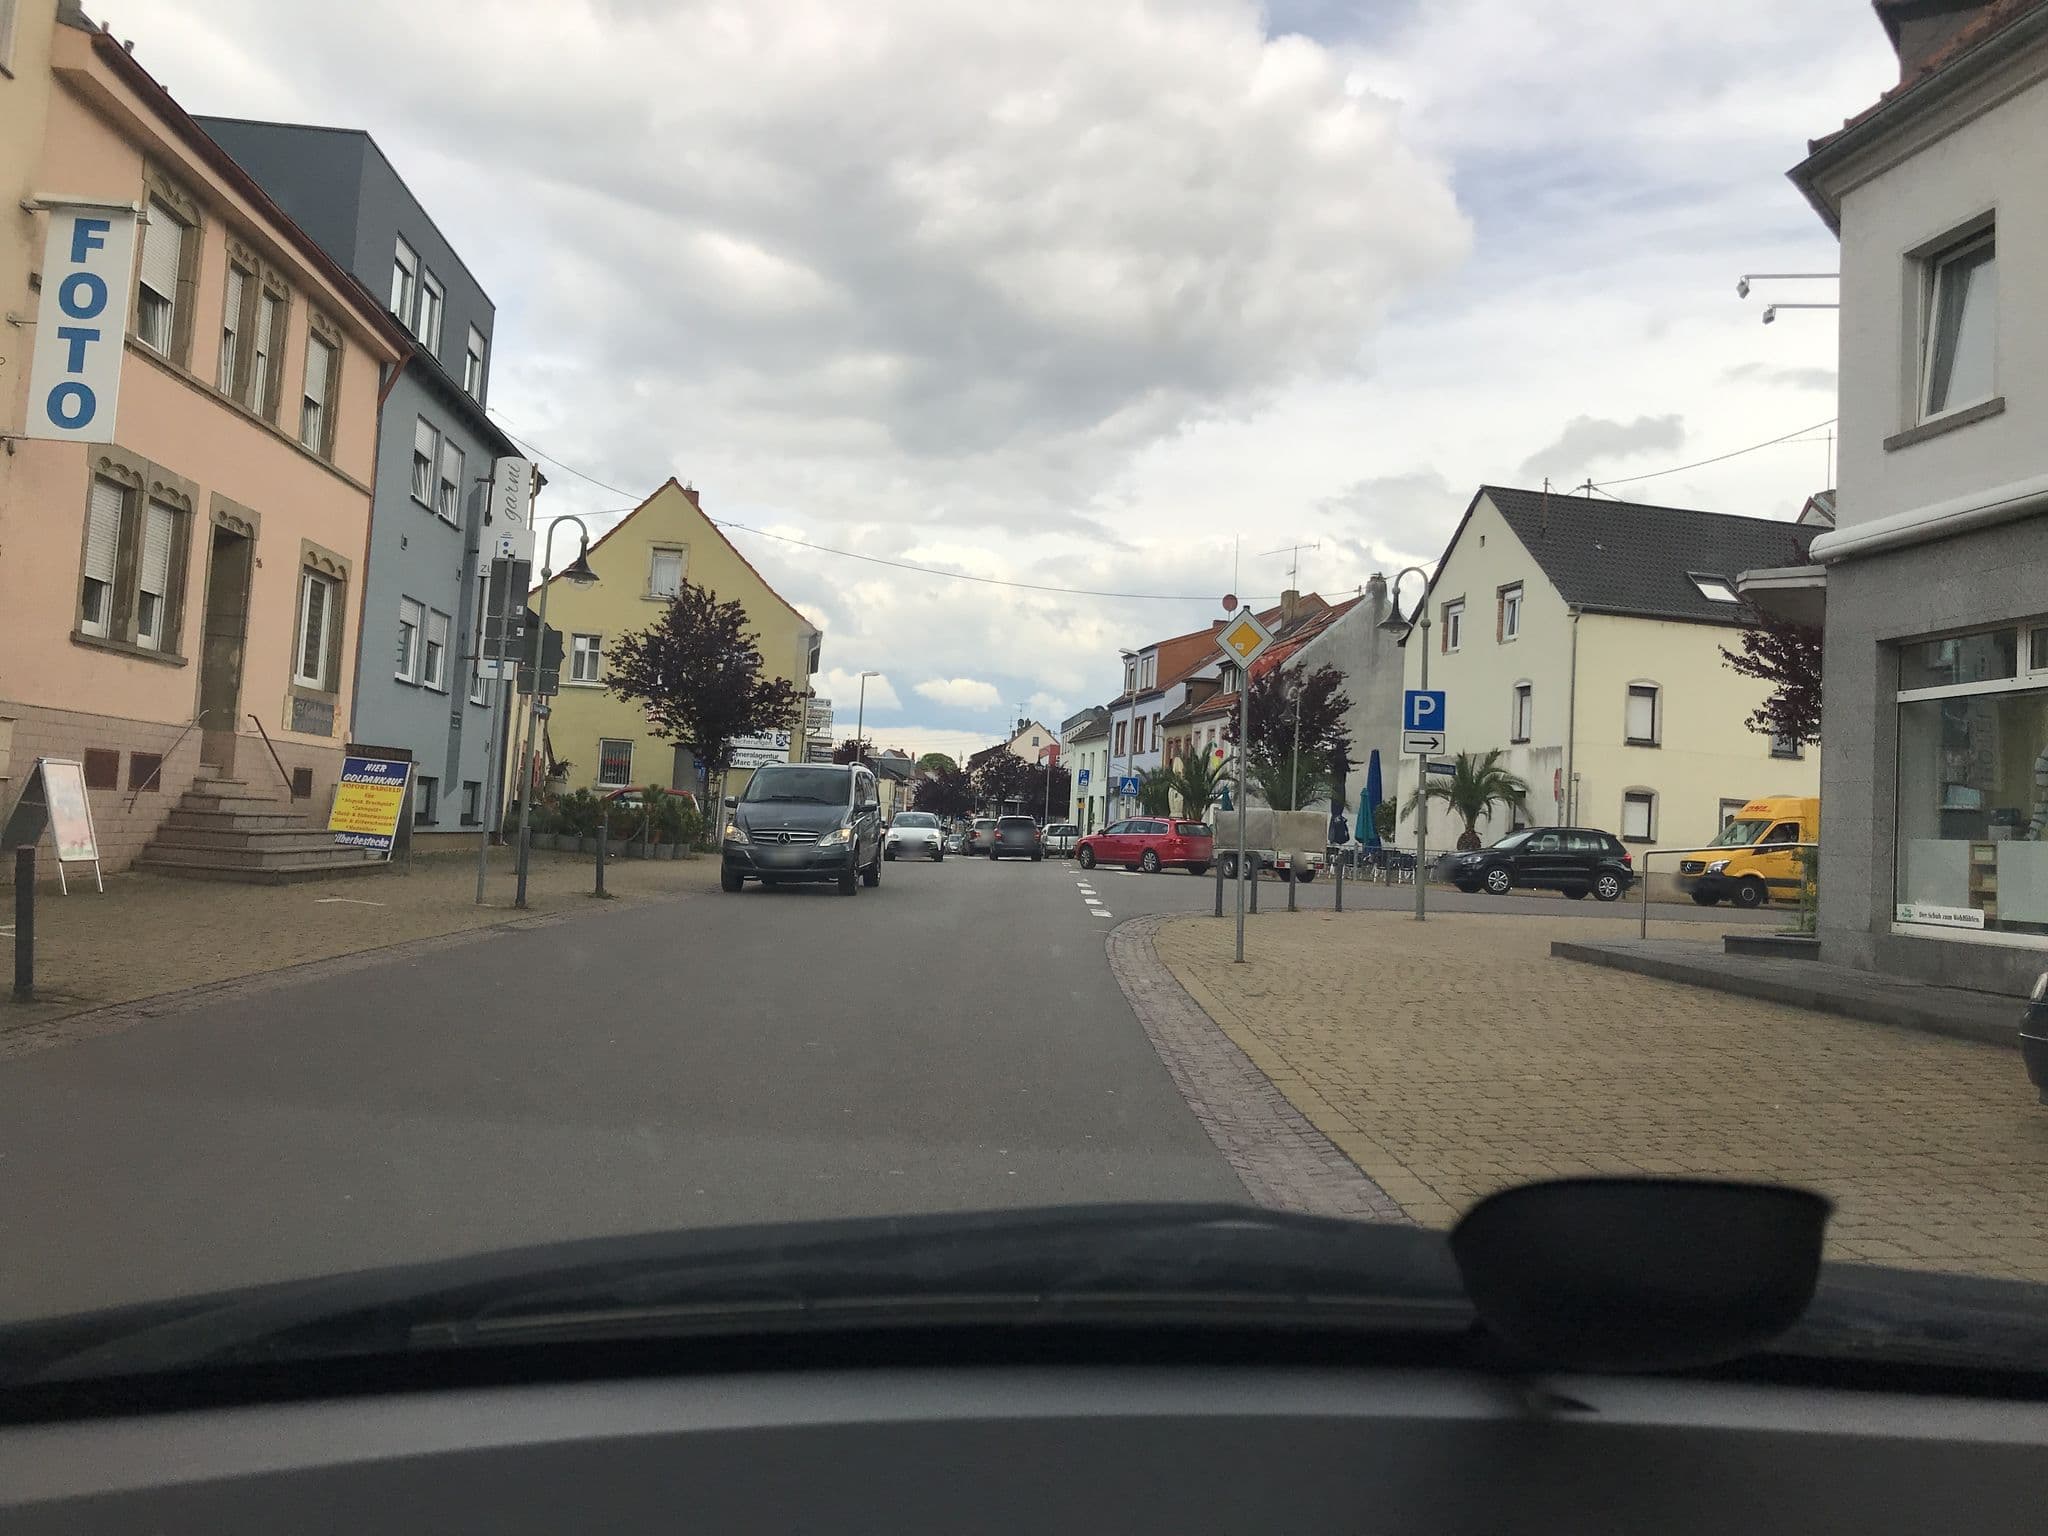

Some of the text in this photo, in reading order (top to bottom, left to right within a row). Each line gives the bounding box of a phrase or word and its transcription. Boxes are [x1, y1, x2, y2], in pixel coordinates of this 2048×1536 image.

[45, 217, 111, 430] FOTO
[504, 463, 523, 524] garni
[1413, 695, 1436, 726] P
[364, 763, 387, 772] HIER
[343, 773, 404, 785] GOLDANKAUF
[335, 833, 389, 847] ilberbestecke
